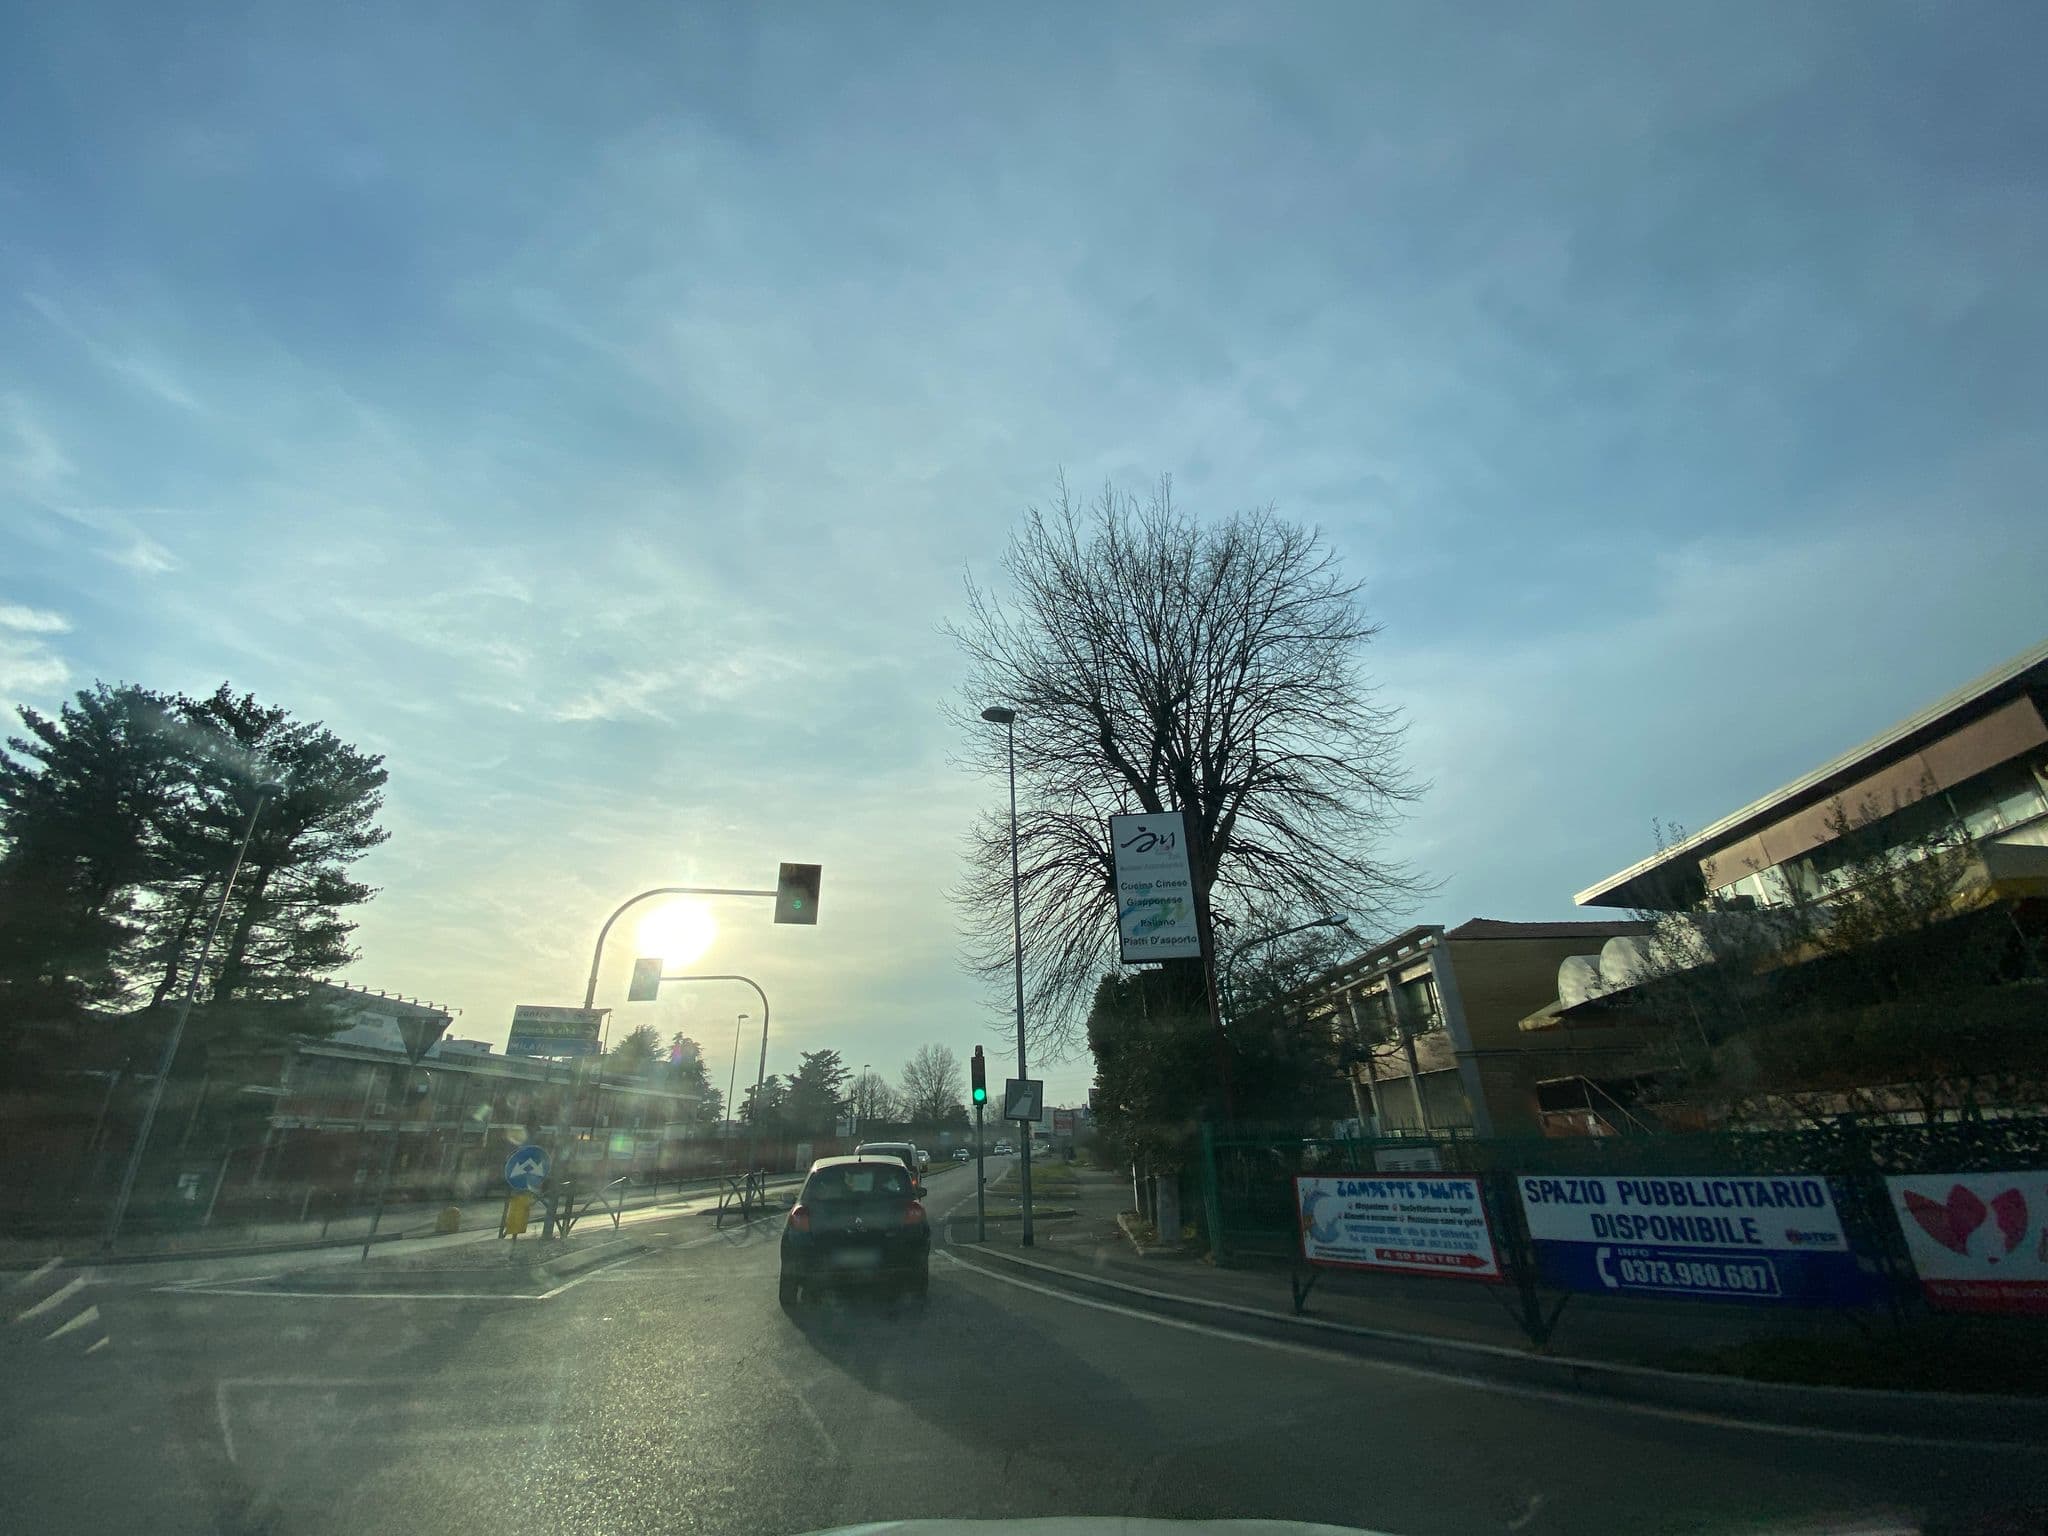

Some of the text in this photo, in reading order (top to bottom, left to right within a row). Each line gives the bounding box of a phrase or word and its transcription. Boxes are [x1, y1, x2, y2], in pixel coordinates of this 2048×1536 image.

[1121, 880, 1187, 891] Cucina Cinese
[1127, 897, 1183, 908] Giapponese
[1140, 918, 1176, 928] Italiano
[1124, 935, 1197, 947] Piatti D'asporto
[1524, 1179, 1825, 1208] SPAZIO PUBBLICITARIO
[1590, 1213, 1762, 1244] DISPONIBILE
[1620, 1258, 1768, 1291] 0373.980.687
